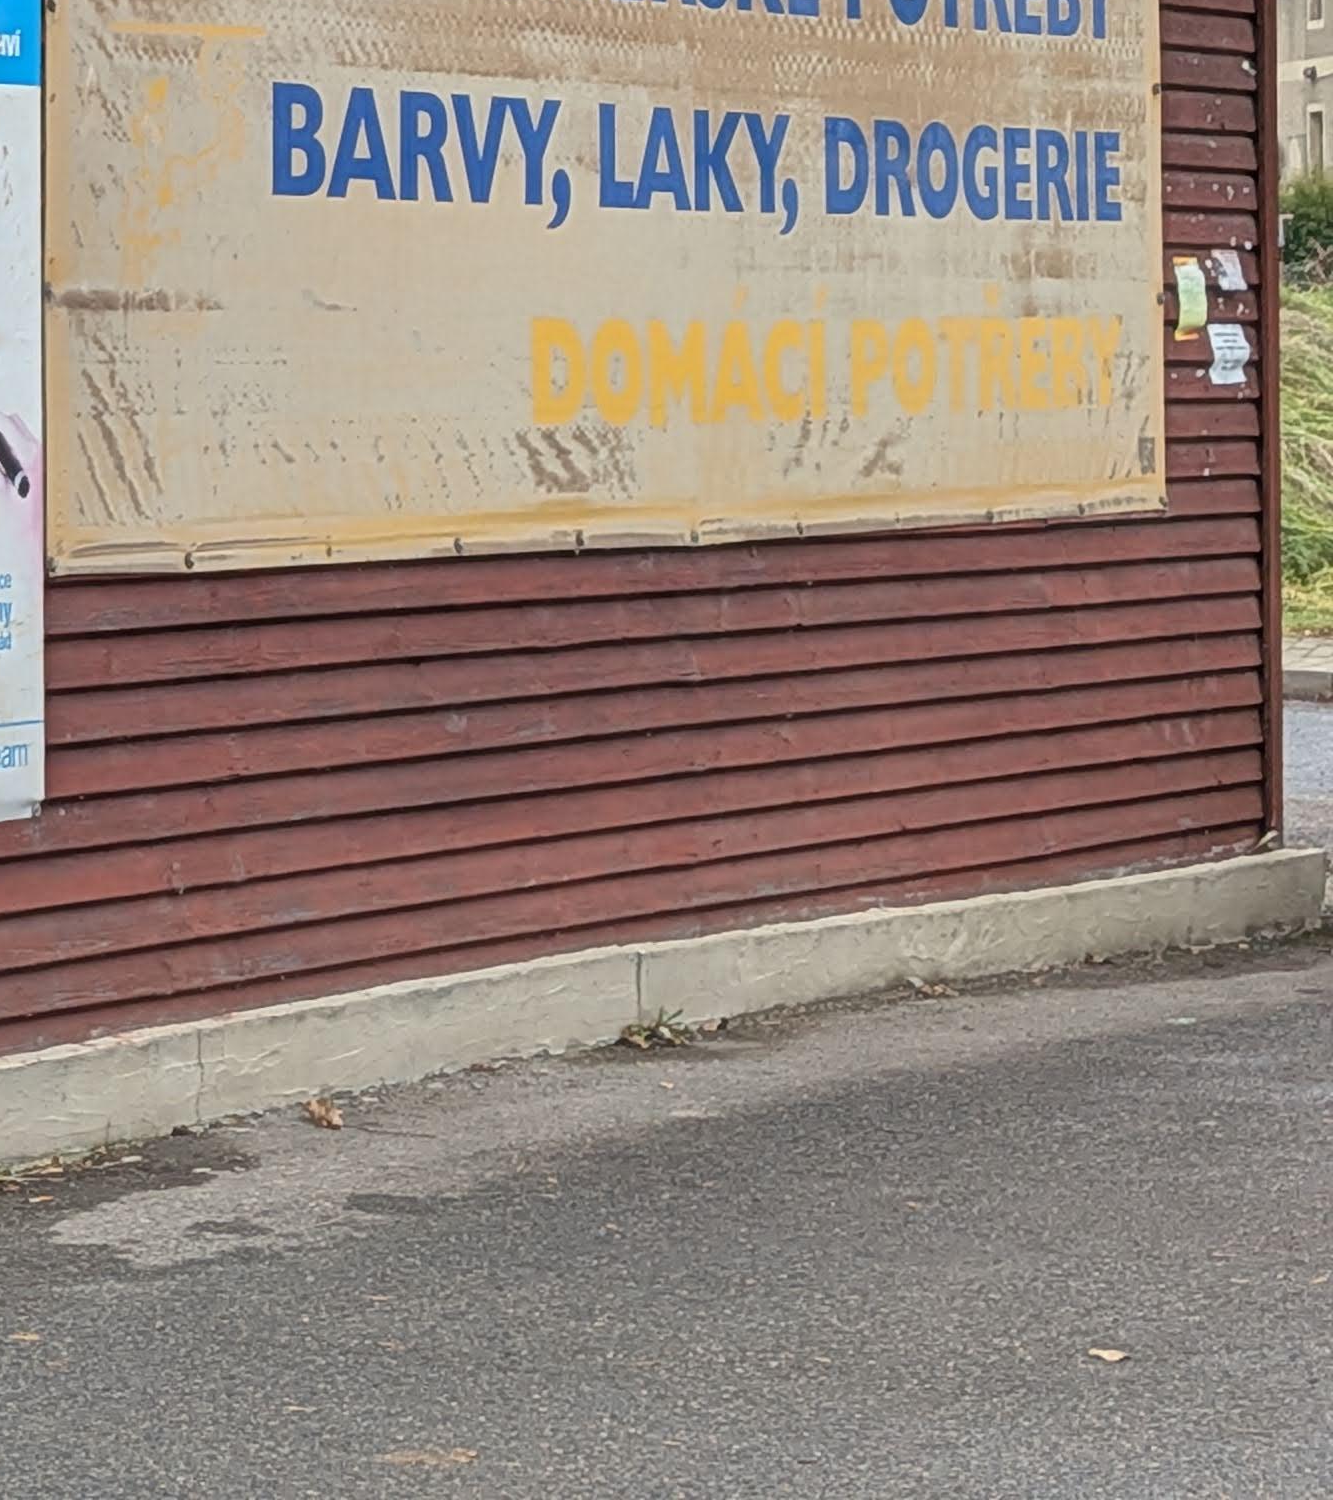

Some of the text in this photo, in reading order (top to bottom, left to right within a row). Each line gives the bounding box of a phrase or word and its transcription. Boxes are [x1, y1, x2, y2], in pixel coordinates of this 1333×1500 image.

[271, 80, 1124, 236] BARVY, LAKY, DROGERIE
[529, 283, 828, 428] DOMÁCÍ
